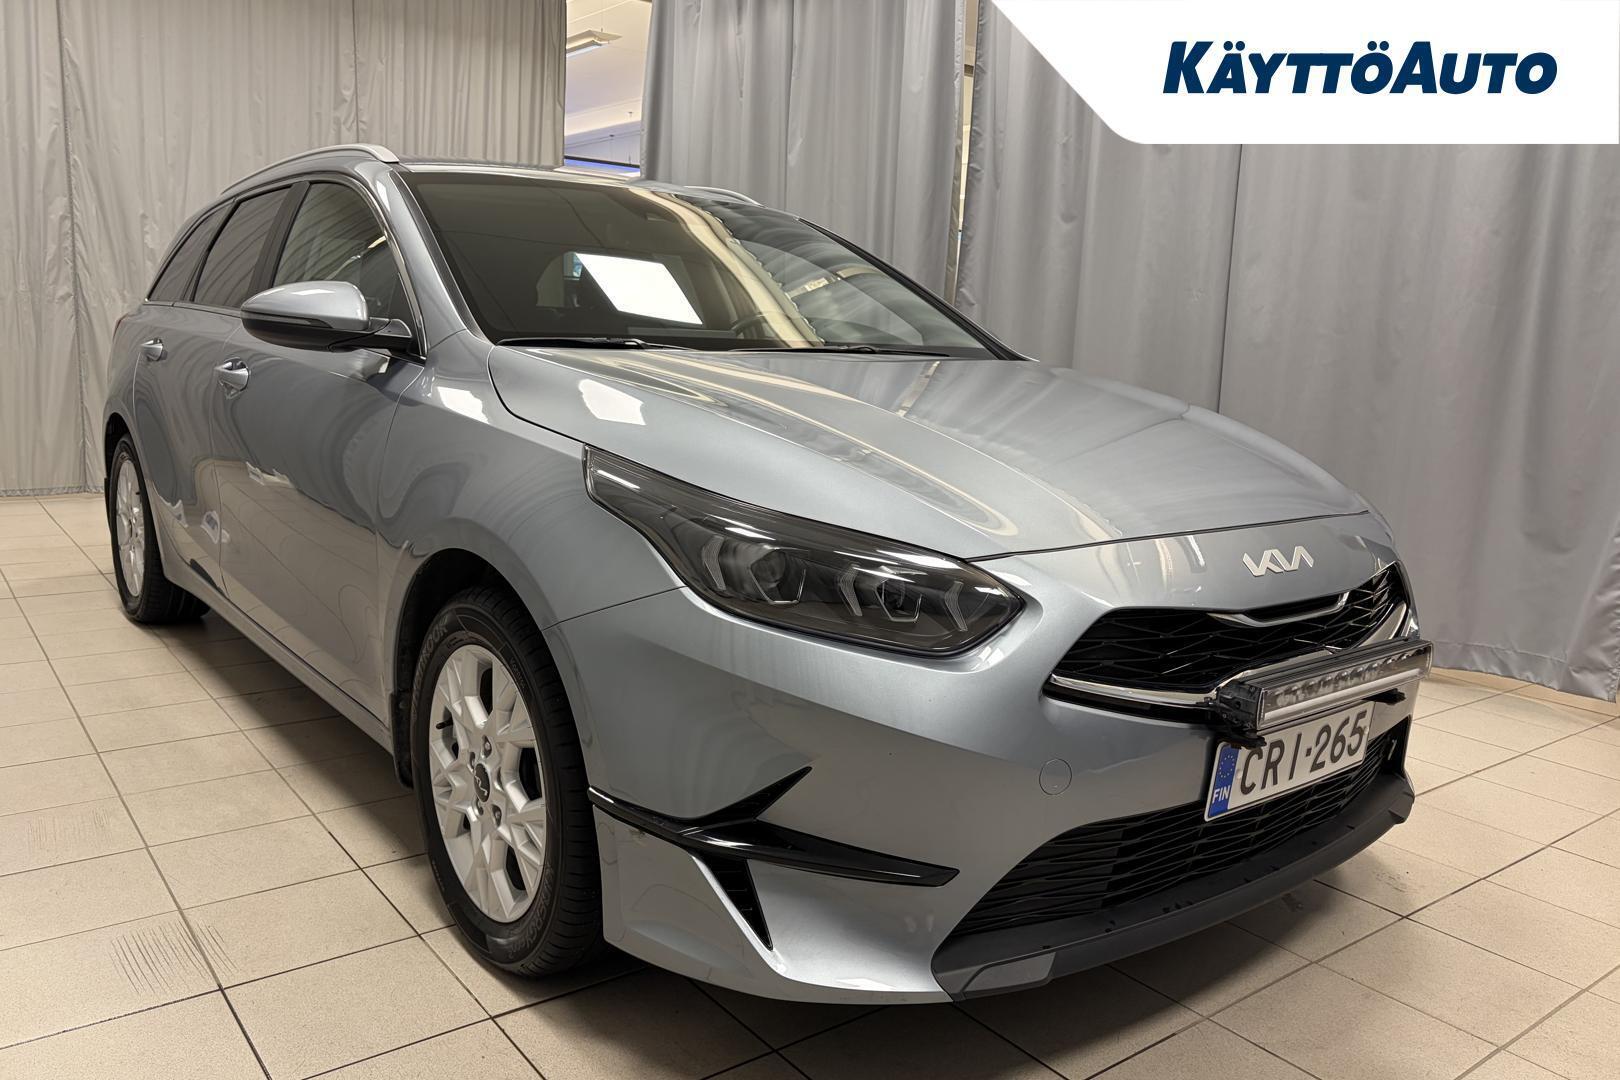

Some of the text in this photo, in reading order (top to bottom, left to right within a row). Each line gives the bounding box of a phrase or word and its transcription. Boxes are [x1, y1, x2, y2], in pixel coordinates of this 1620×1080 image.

[1242, 545, 1314, 577] KIA
[1240, 709, 1368, 796] CRI-265
[1212, 785, 1231, 804] FIN
